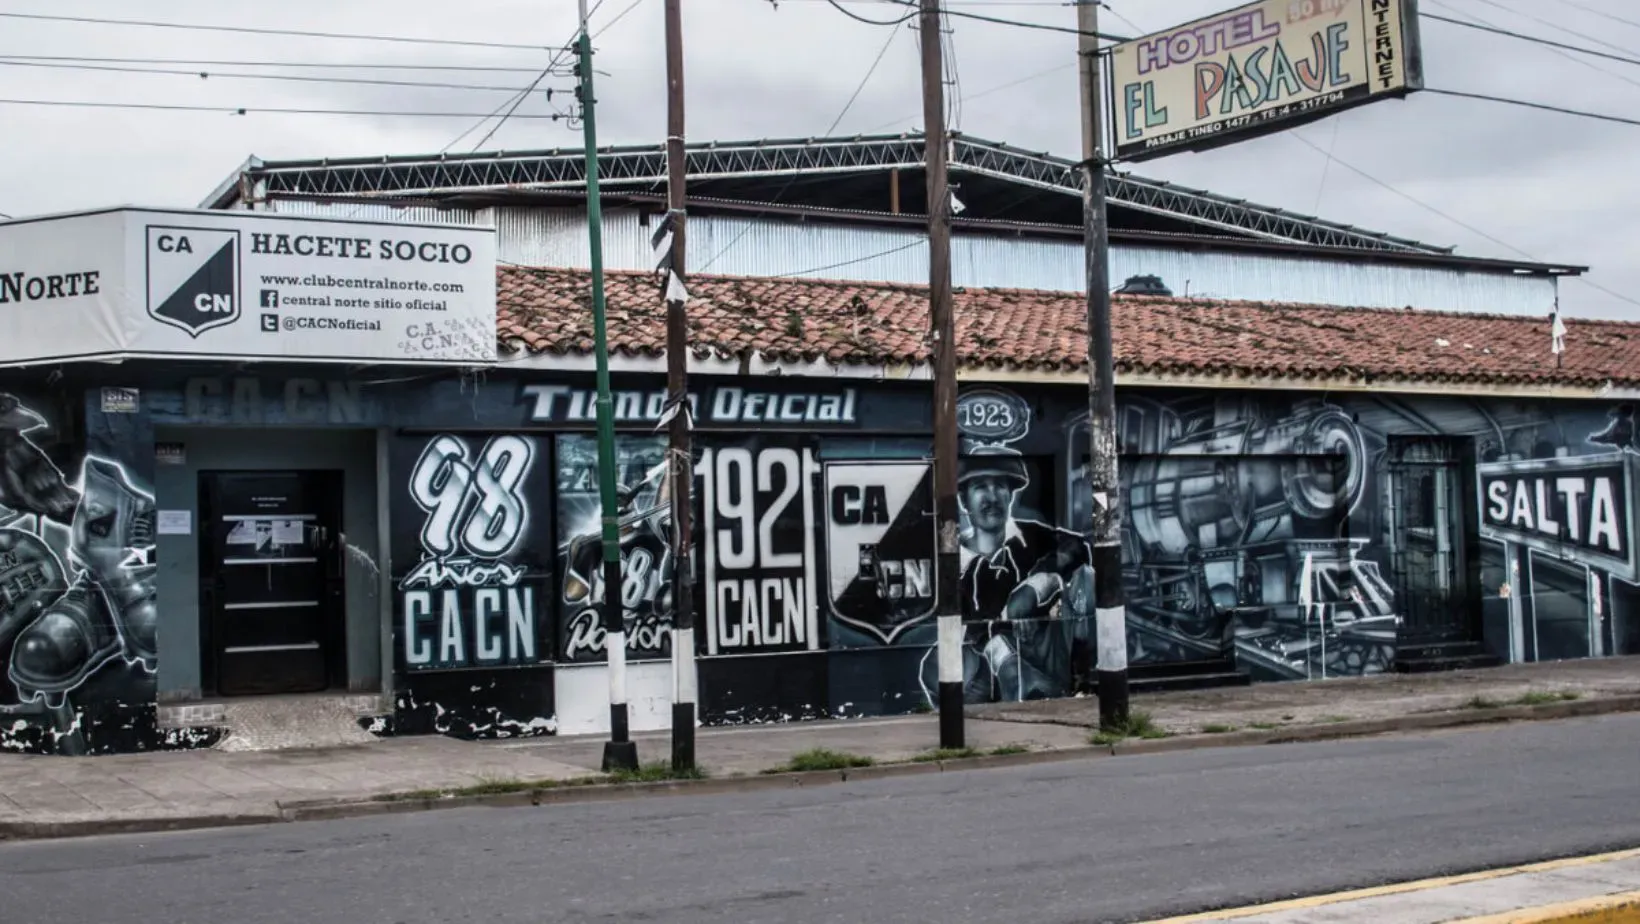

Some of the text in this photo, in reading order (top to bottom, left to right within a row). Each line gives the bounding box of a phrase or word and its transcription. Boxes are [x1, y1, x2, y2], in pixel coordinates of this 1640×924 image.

[1137, 7, 1280, 75] HOTEL
[1124, 22, 1351, 139] EL PASAJE
[1146, 131, 1185, 147] PASAJE
[1188, 122, 1222, 138] TINEO
[1225, 114, 1250, 129] 1477
[1261, 110, 1276, 121] TE
[1300, 92, 1344, 112] 317794
[157, 234, 193, 254] CA
[251, 232, 472, 264] HACETE SOCIO
[0, 271, 99, 303] NORTE
[194, 293, 232, 313] CN
[260, 274, 465, 294] www.clubcentralnorte.com
[282, 294, 331, 307] central
[334, 296, 371, 309] norte
[373, 296, 402, 310] sitio
[405, 297, 448, 311] oficial
[282, 315, 381, 332] @CACNoficial
[711, 387, 856, 421] Oficial
[957, 403, 1013, 427] 1923
[409, 434, 532, 559] 98
[831, 485, 889, 525] CA
[1488, 475, 1622, 551] SALTA
[880, 559, 932, 598] CN
[405, 587, 534, 664] CACN
[718, 577, 804, 648] CACN
[566, 609, 672, 660] Paión
